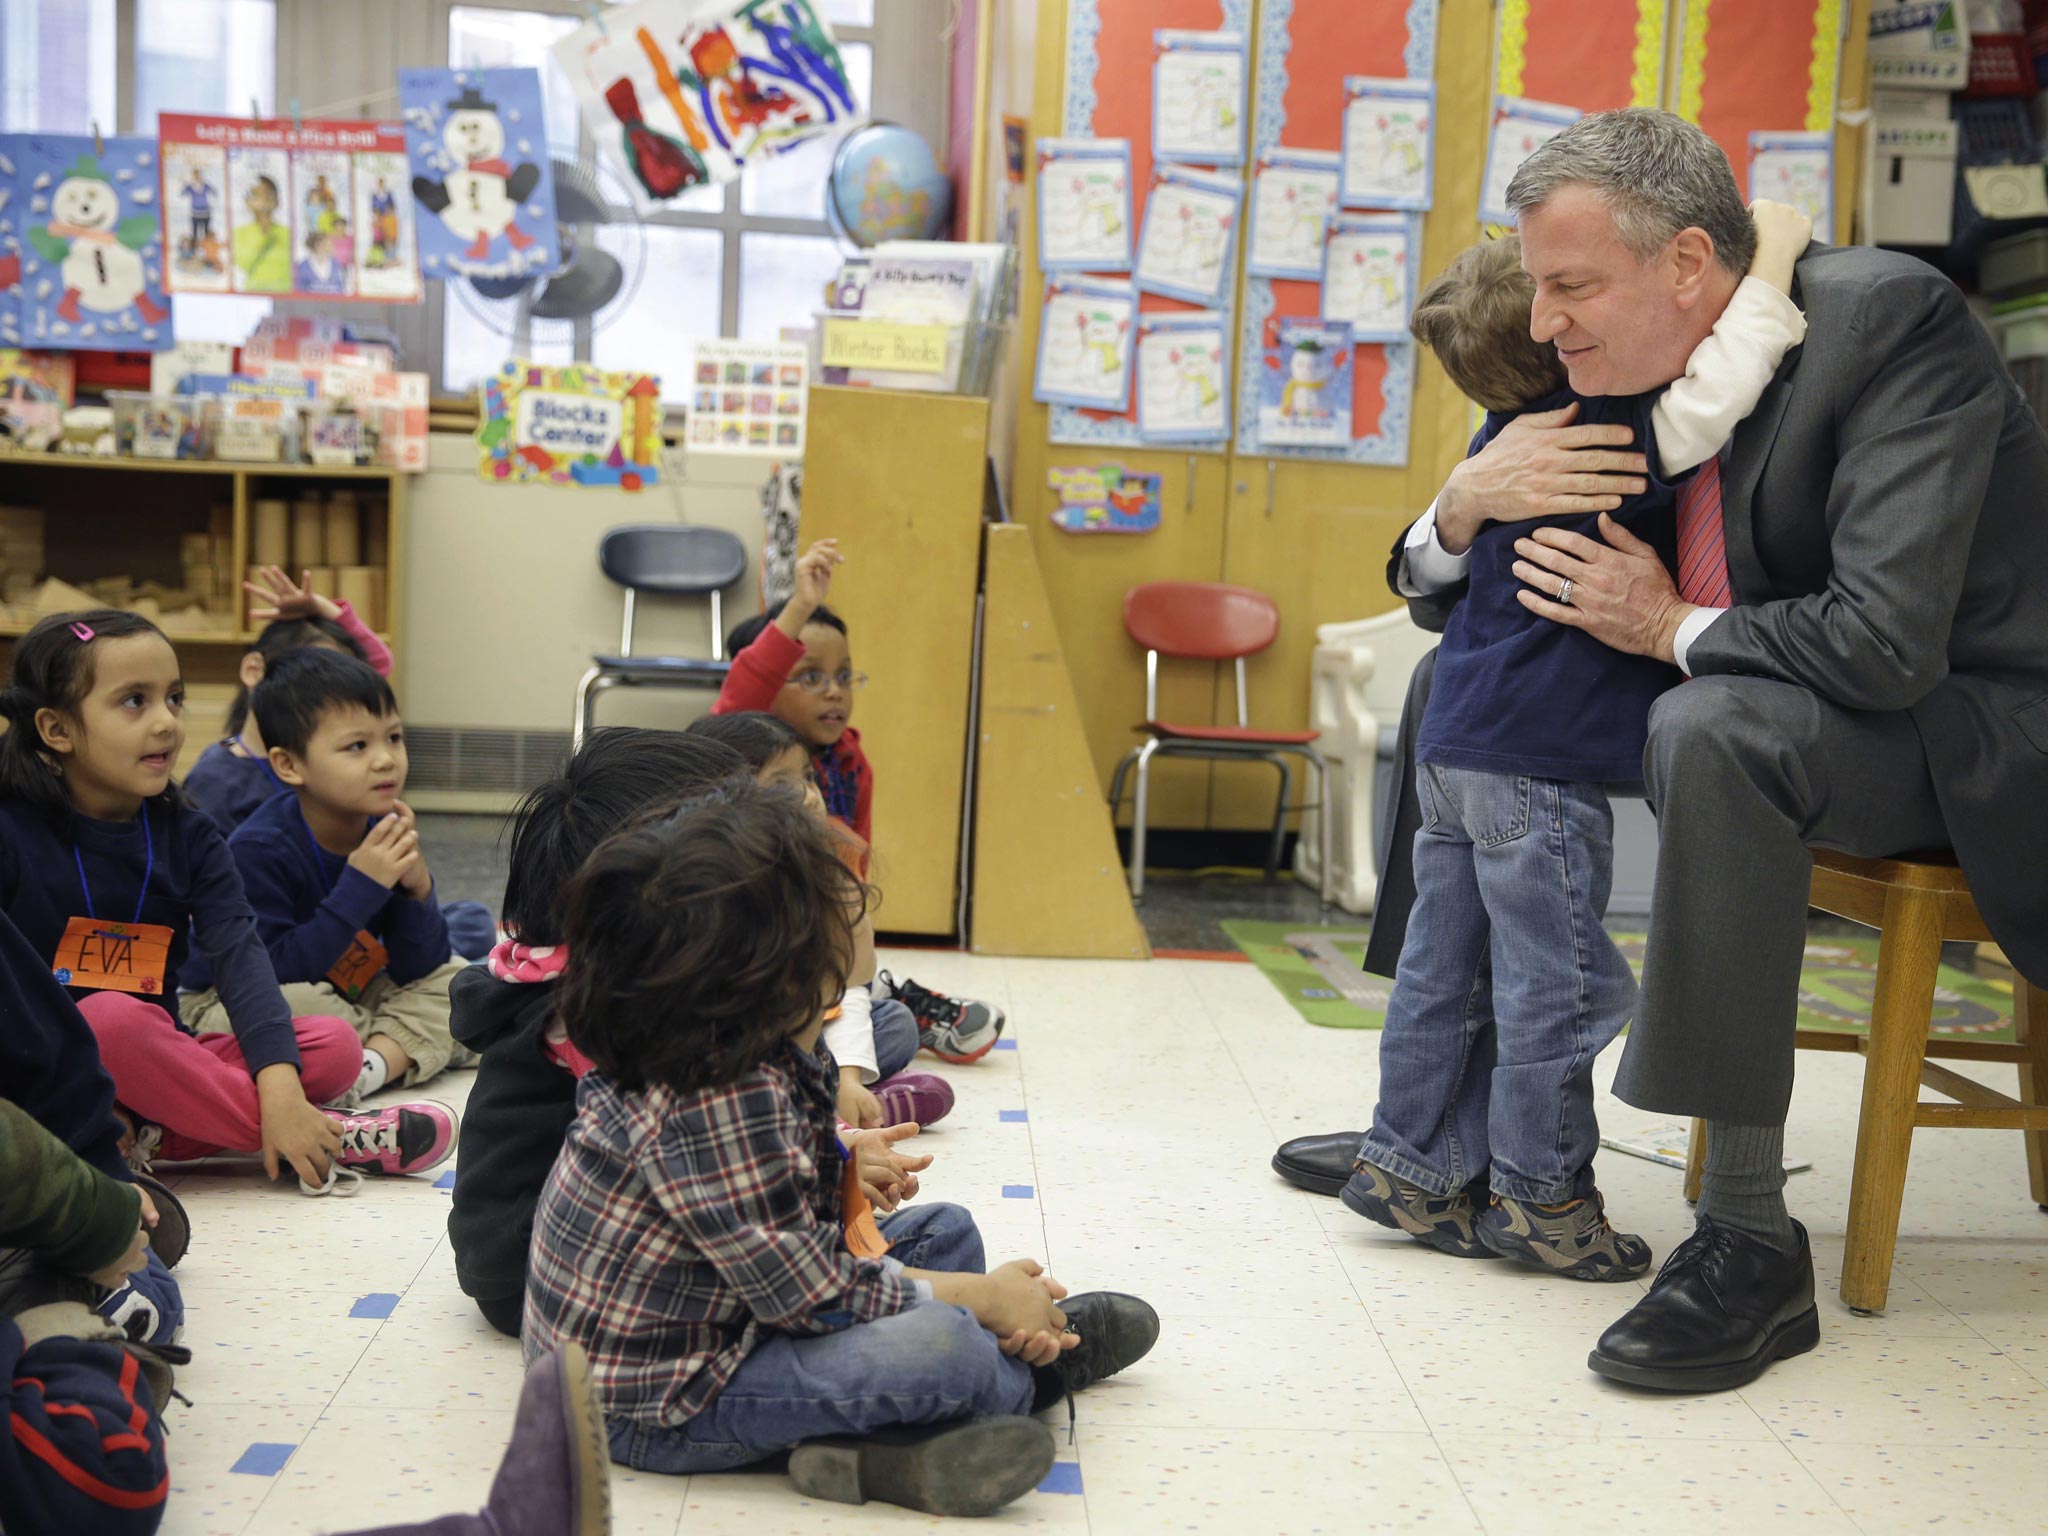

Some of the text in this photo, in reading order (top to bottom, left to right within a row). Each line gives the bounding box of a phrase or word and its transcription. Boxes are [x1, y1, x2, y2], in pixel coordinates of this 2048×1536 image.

[195, 122, 239, 144] Let's
[300, 128, 337, 147] Fire
[829, 331, 886, 359] Winter
[892, 333, 940, 363] Books
[534, 399, 608, 425] Blocks
[529, 420, 607, 446] Center
[76, 934, 133, 975] EVA
